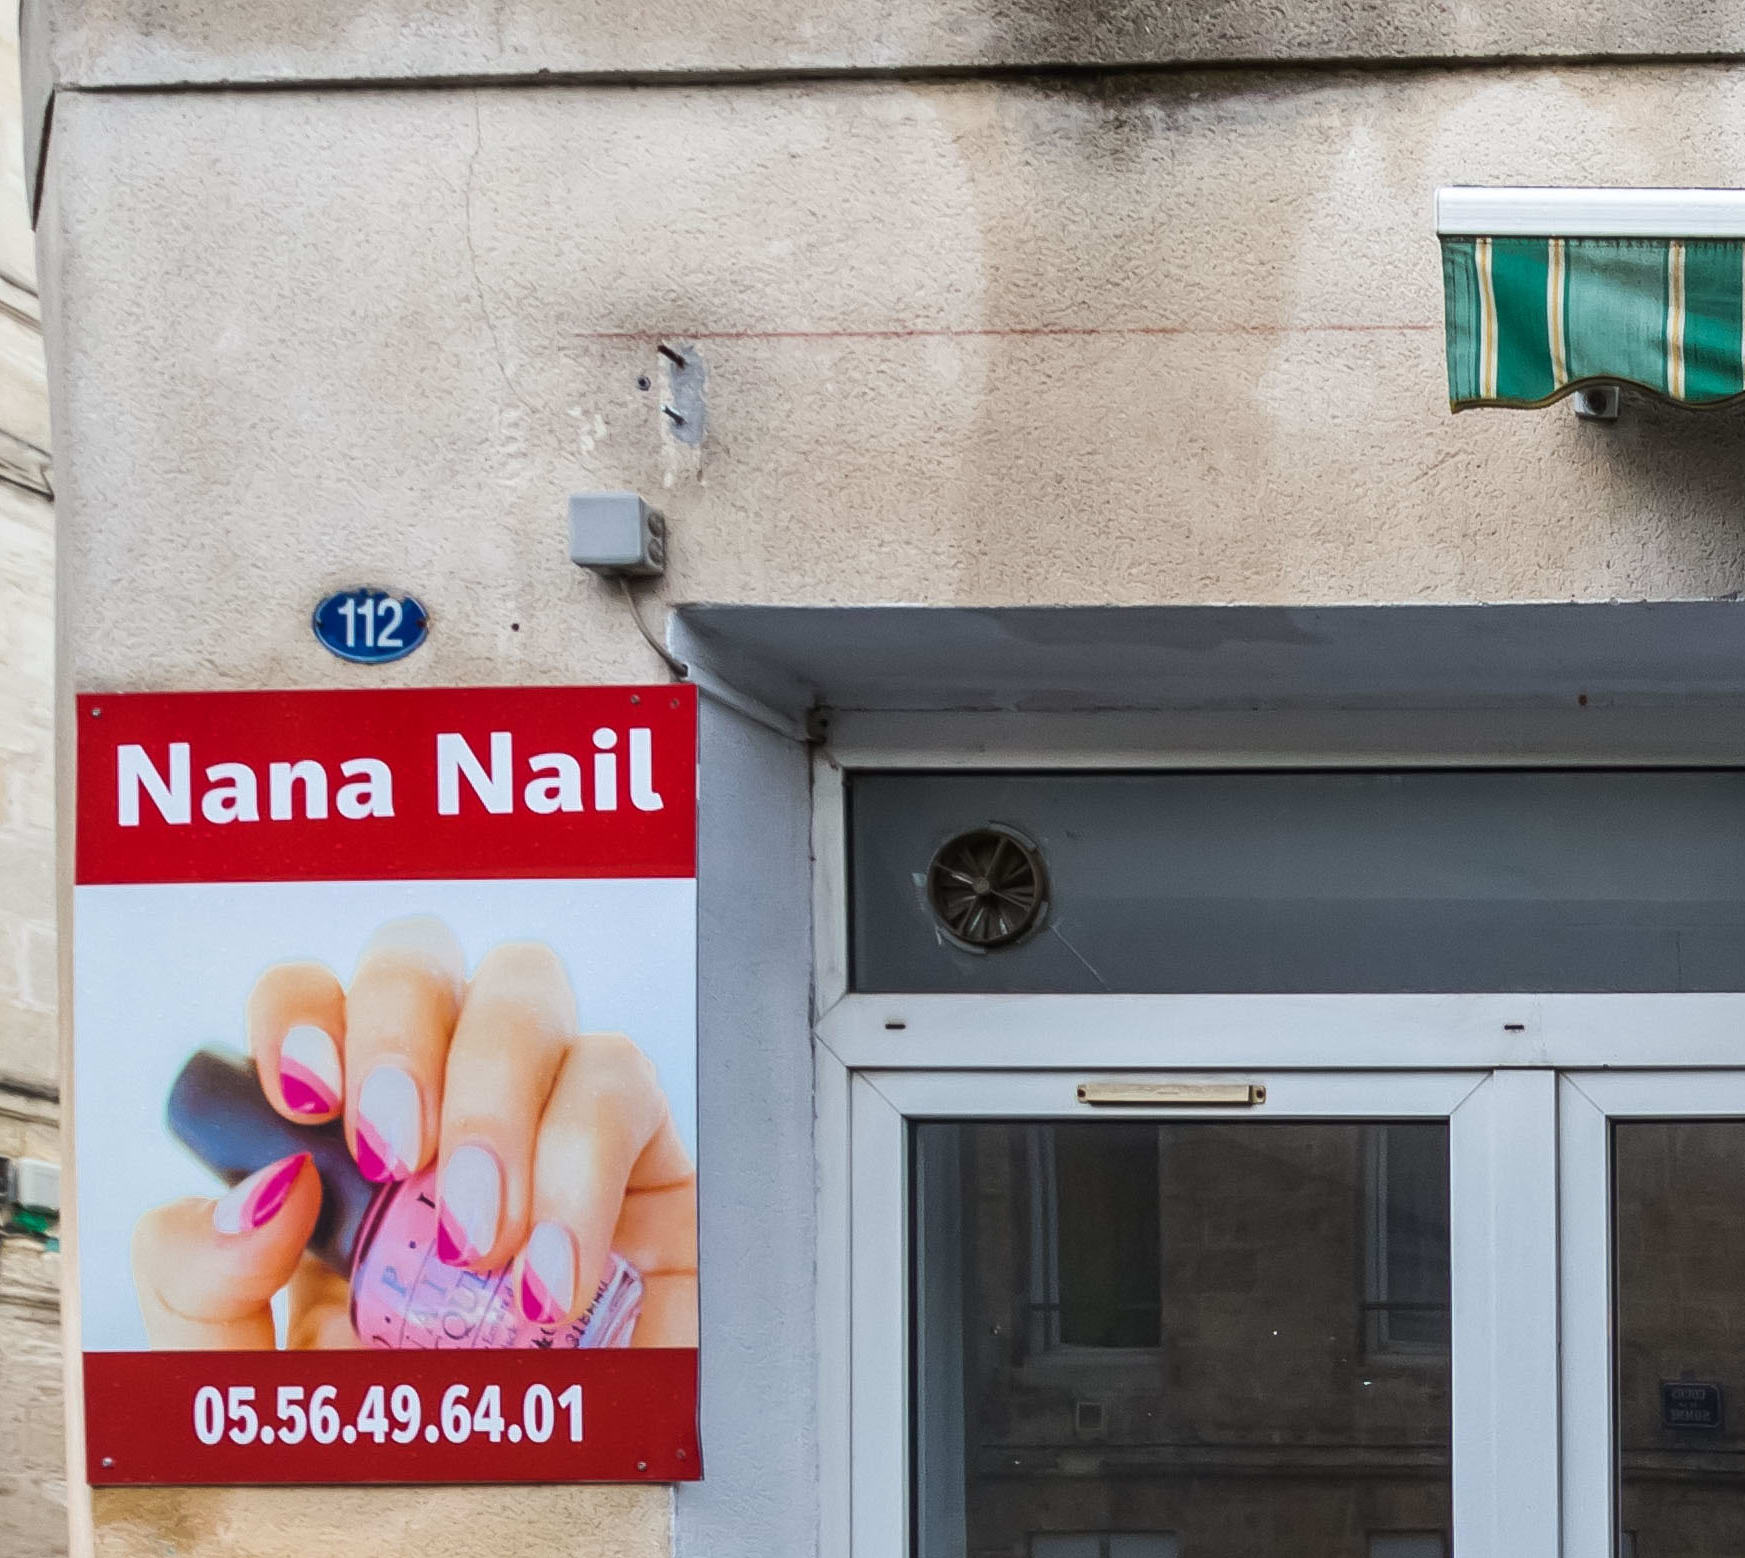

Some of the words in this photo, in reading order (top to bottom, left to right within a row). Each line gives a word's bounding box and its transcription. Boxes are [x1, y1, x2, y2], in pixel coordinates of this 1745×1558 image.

[337, 598, 405, 649] 112
[117, 742, 395, 827] Nana
[437, 727, 664, 816] Nail
[194, 1383, 585, 1445] 05.56.49.64.01
